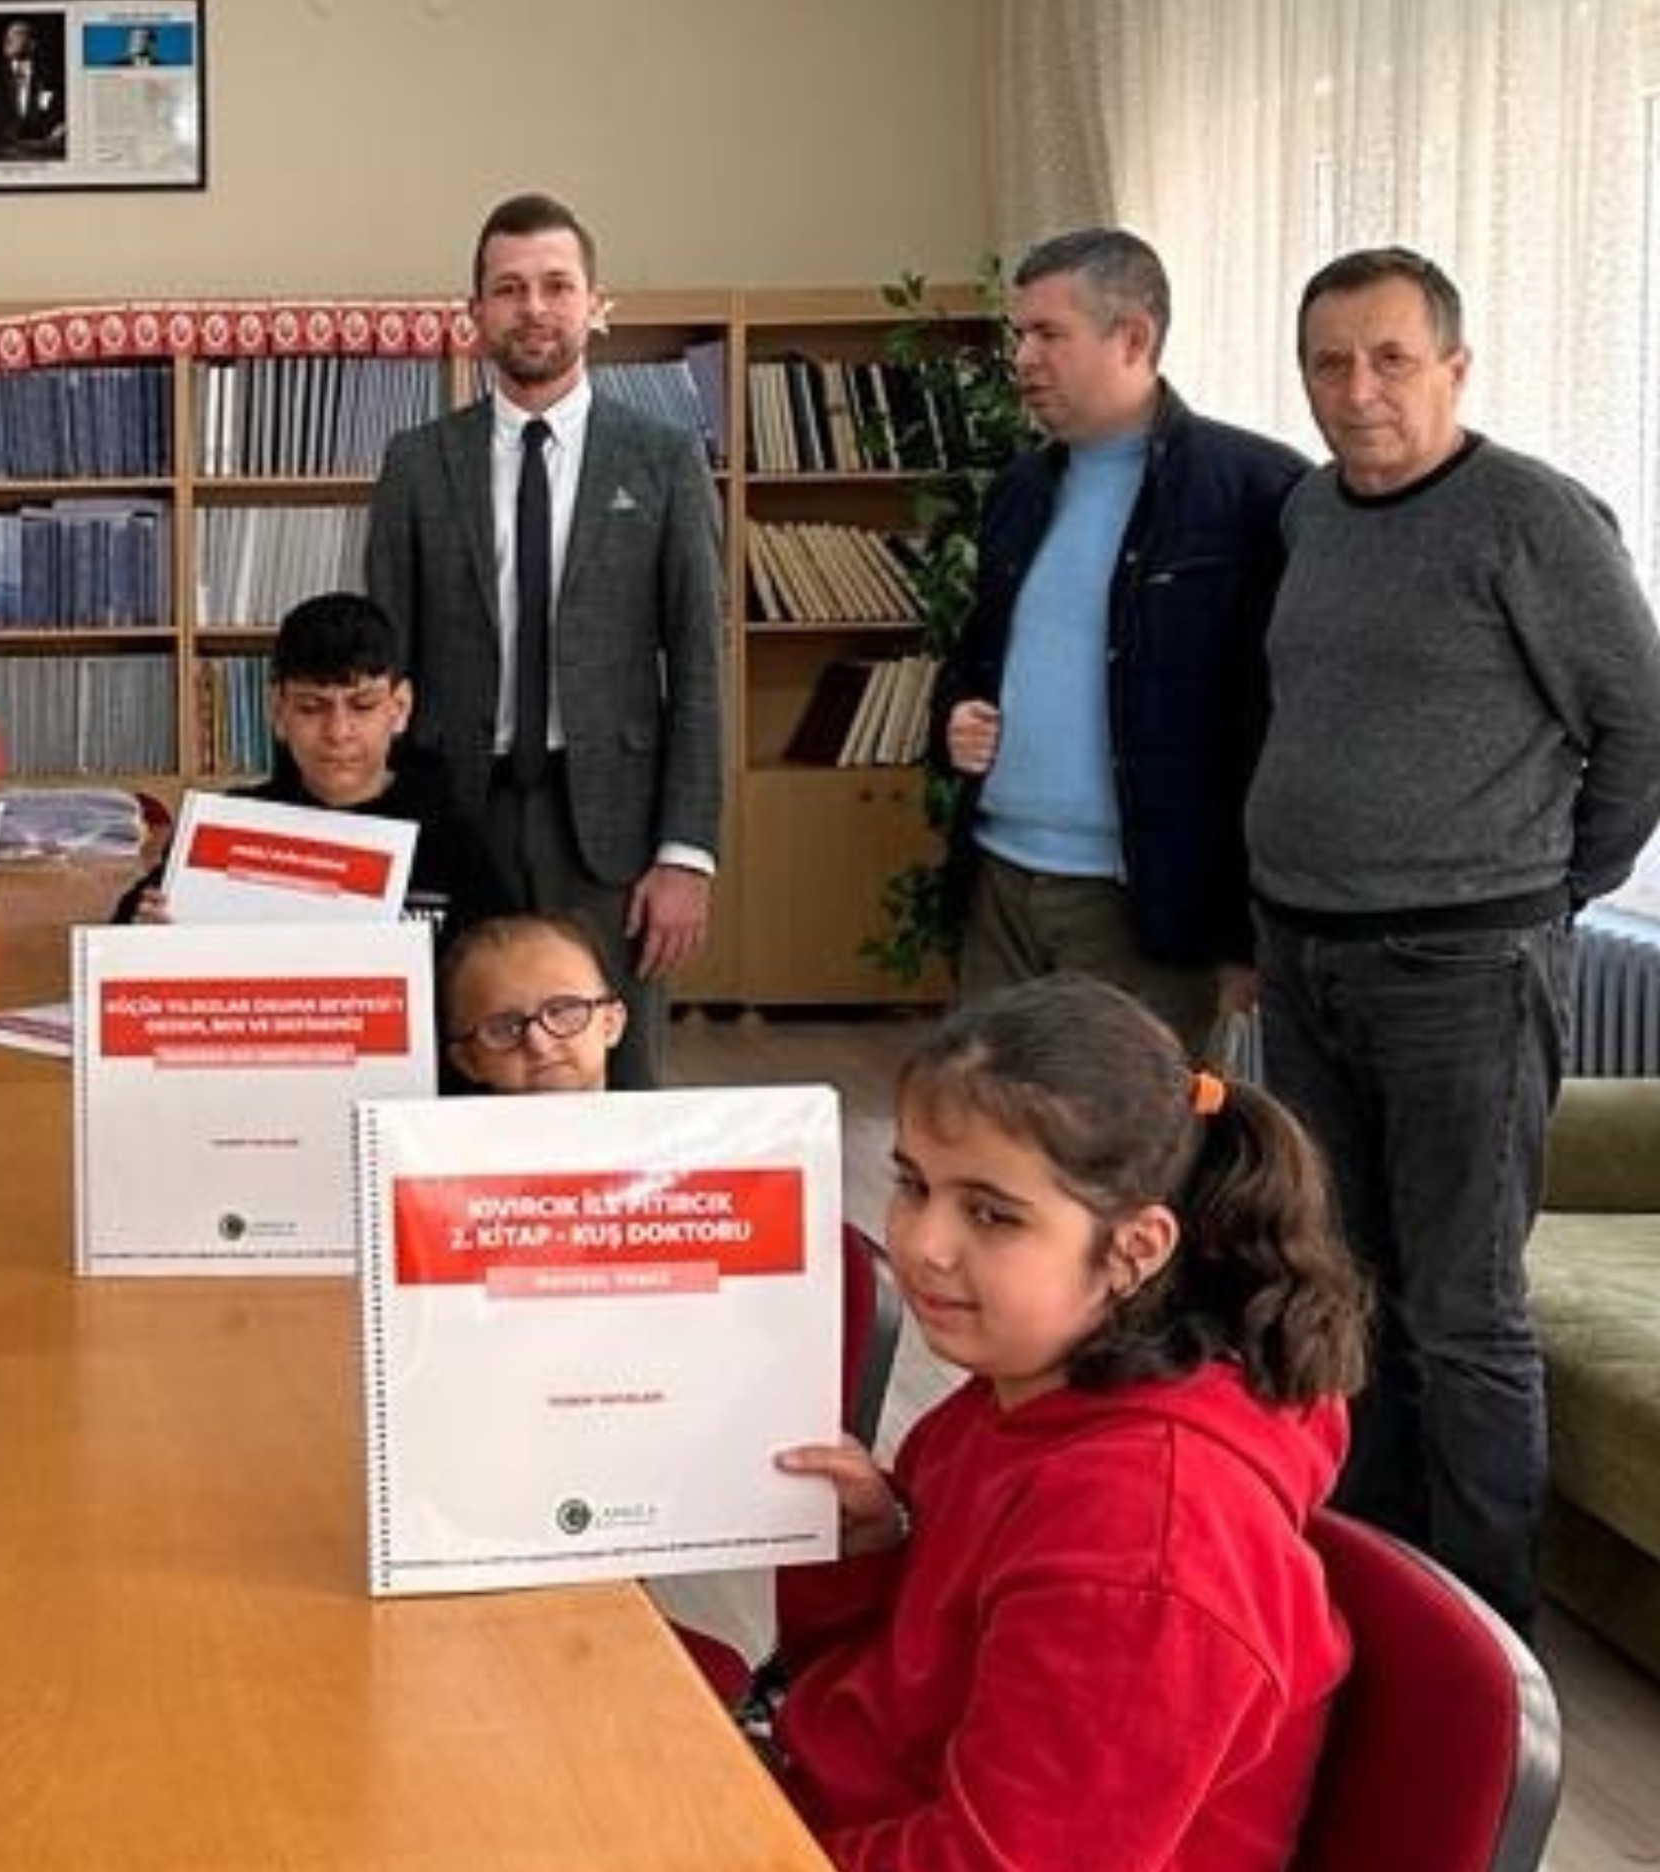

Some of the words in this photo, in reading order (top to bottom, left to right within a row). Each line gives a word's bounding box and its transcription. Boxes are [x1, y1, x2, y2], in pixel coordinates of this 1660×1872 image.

[476, 1219, 553, 1248] KİTAP
[571, 1221, 624, 1250] KUŞ
[626, 1218, 751, 1243] DOKTORU
